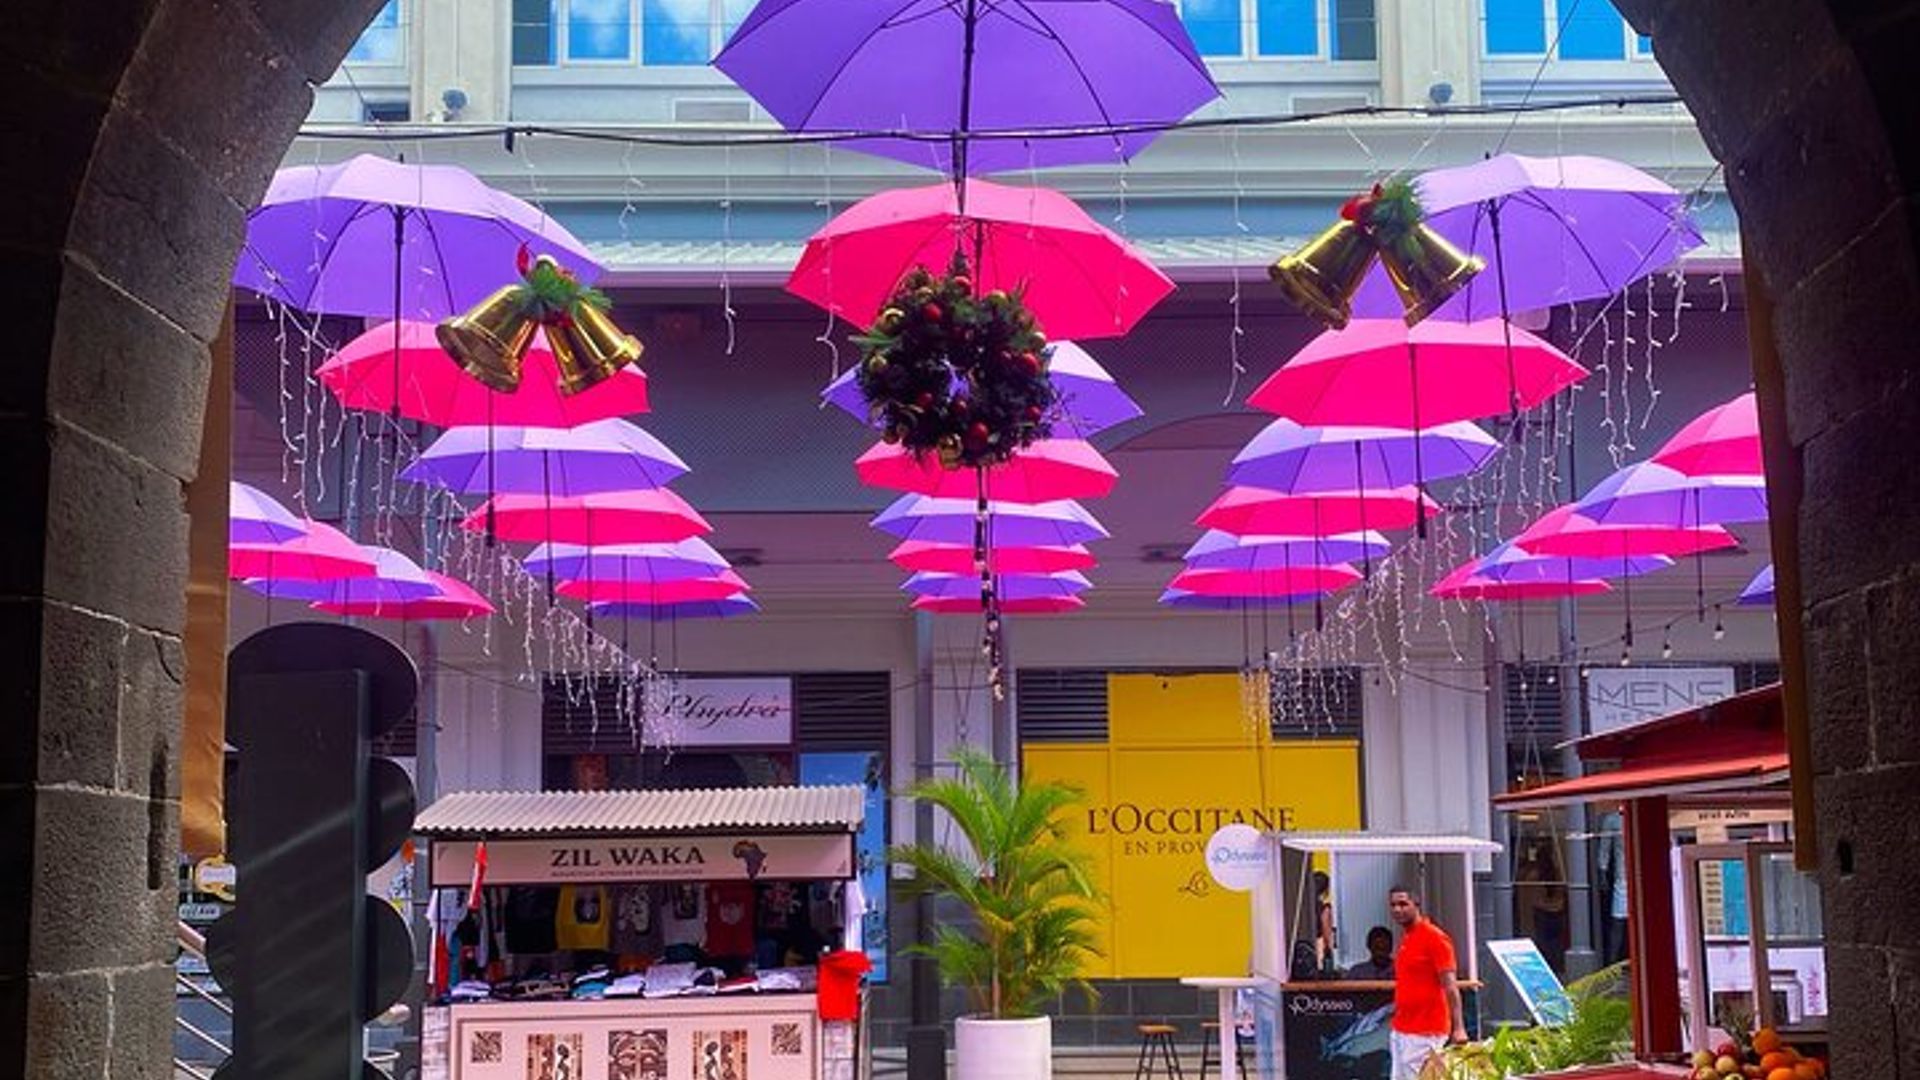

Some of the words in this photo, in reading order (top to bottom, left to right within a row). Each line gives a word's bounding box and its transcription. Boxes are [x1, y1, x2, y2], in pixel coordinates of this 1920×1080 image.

[1597, 681, 1724, 708] MENS
[1088, 804, 1297, 834] L'OCCITANE
[551, 849, 600, 867] ZIL
[609, 847, 705, 865] WAKA
[1124, 841, 1148, 856] EN
[1157, 840, 1206, 854] PROV
